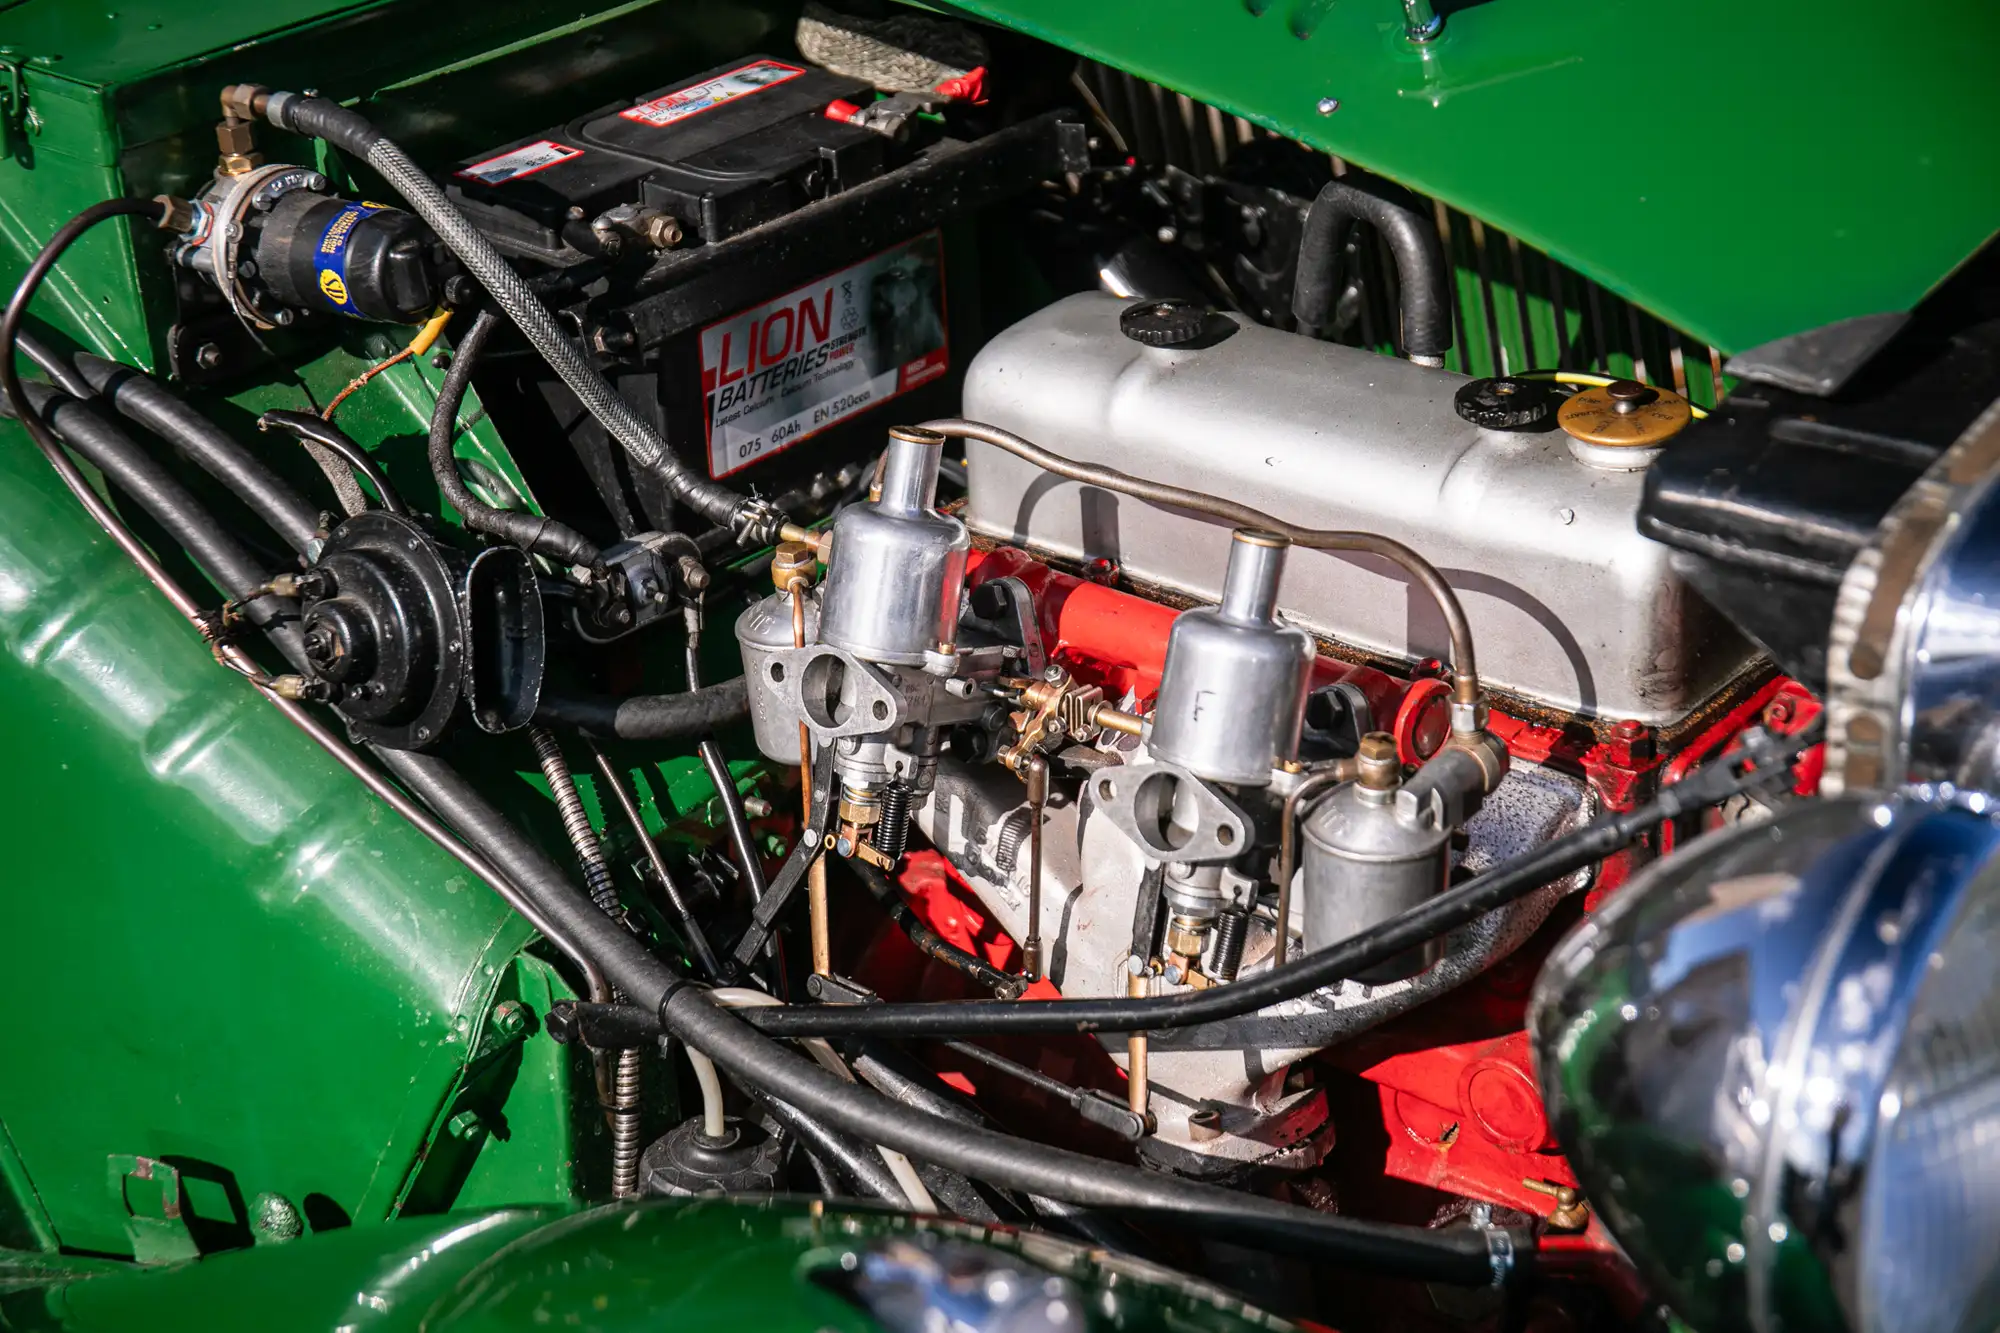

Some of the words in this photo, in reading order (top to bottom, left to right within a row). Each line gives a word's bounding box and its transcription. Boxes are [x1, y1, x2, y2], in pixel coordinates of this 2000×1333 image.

[637, 93, 690, 116] LION
[719, 287, 834, 387] LION
[830, 326, 867, 350] STRENGTH
[718, 343, 831, 413] BATTERIES
[715, 410, 741, 428] Latest
[743, 396, 774, 416] Calcium
[739, 437, 762, 458] 075
[771, 420, 801, 443] 60Ah
[813, 406, 829, 424] EN
